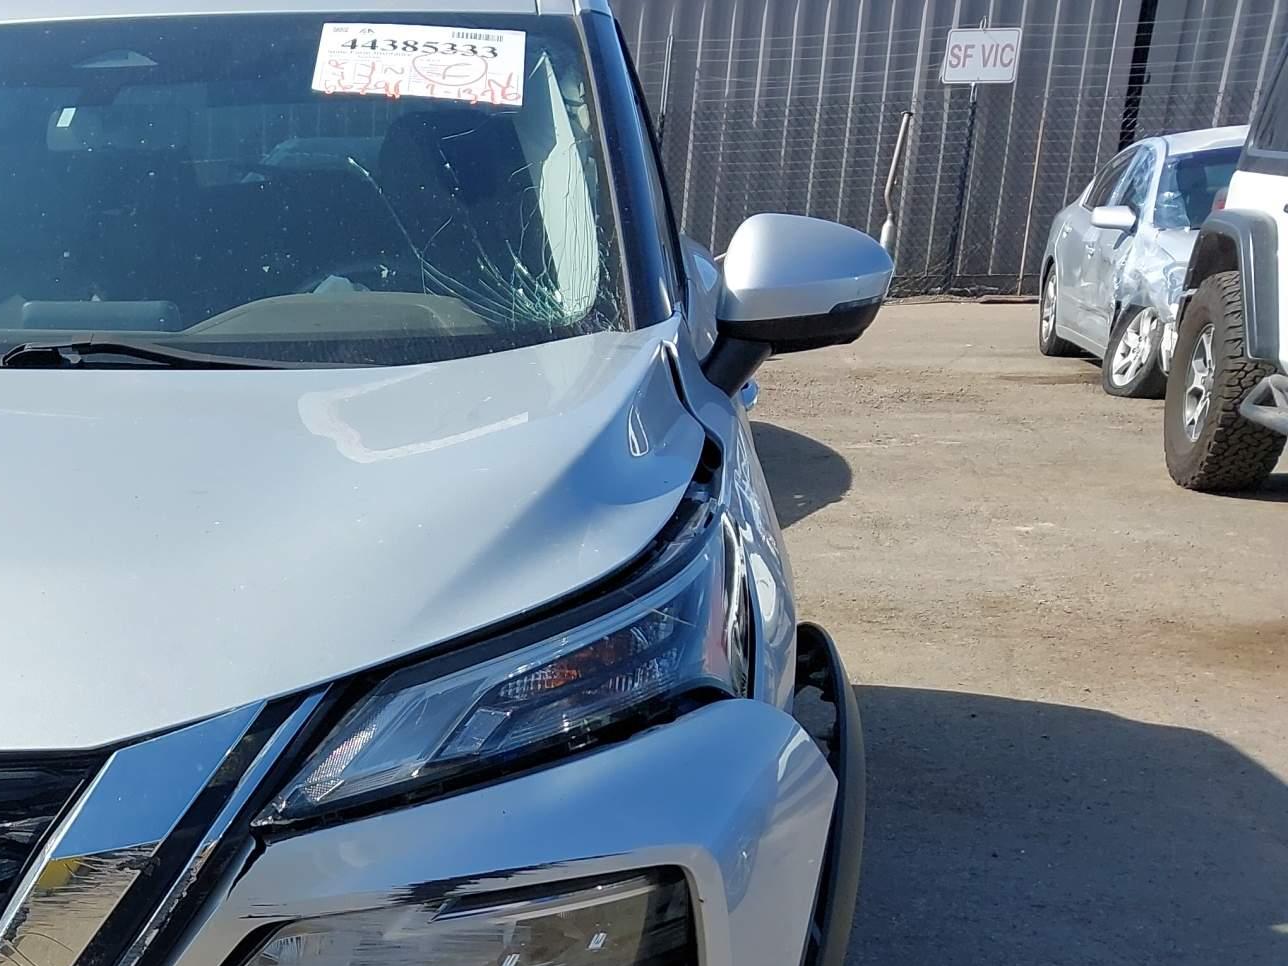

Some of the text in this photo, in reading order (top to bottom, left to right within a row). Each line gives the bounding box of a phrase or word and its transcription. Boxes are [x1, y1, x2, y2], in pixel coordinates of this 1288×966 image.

[341, 38, 499, 59] 44385333
[948, 43, 1015, 68] SF VIC
